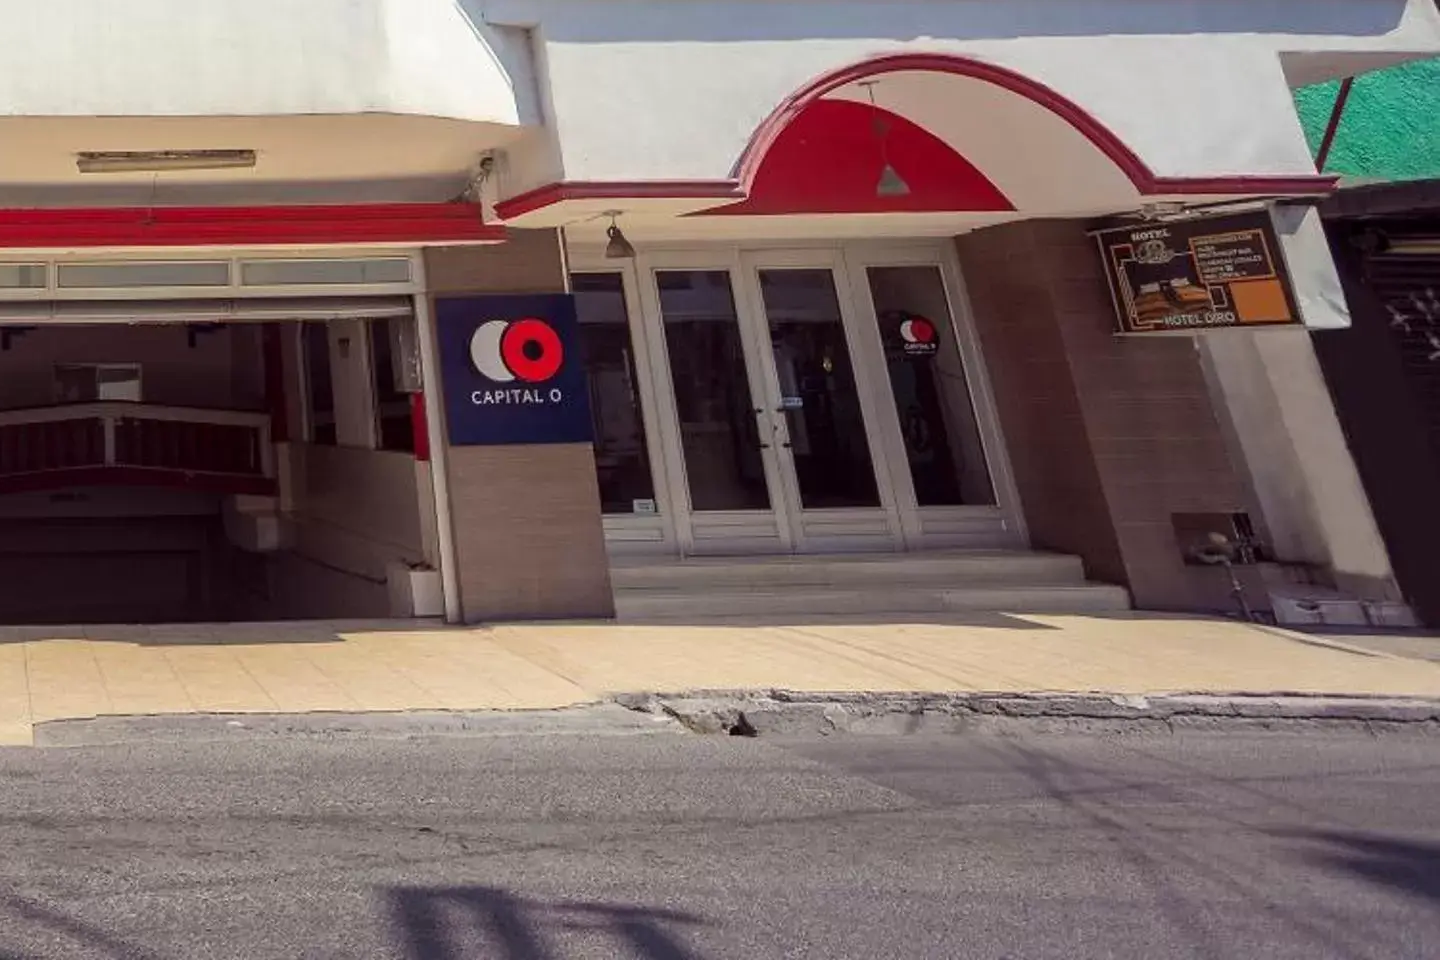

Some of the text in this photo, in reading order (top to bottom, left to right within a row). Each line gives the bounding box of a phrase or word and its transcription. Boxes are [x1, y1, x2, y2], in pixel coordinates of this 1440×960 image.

[1131, 229, 1172, 241] HOTEL
[1164, 311, 1236, 325] HOTEL DIRO
[471, 388, 562, 404] CAPITAL O
